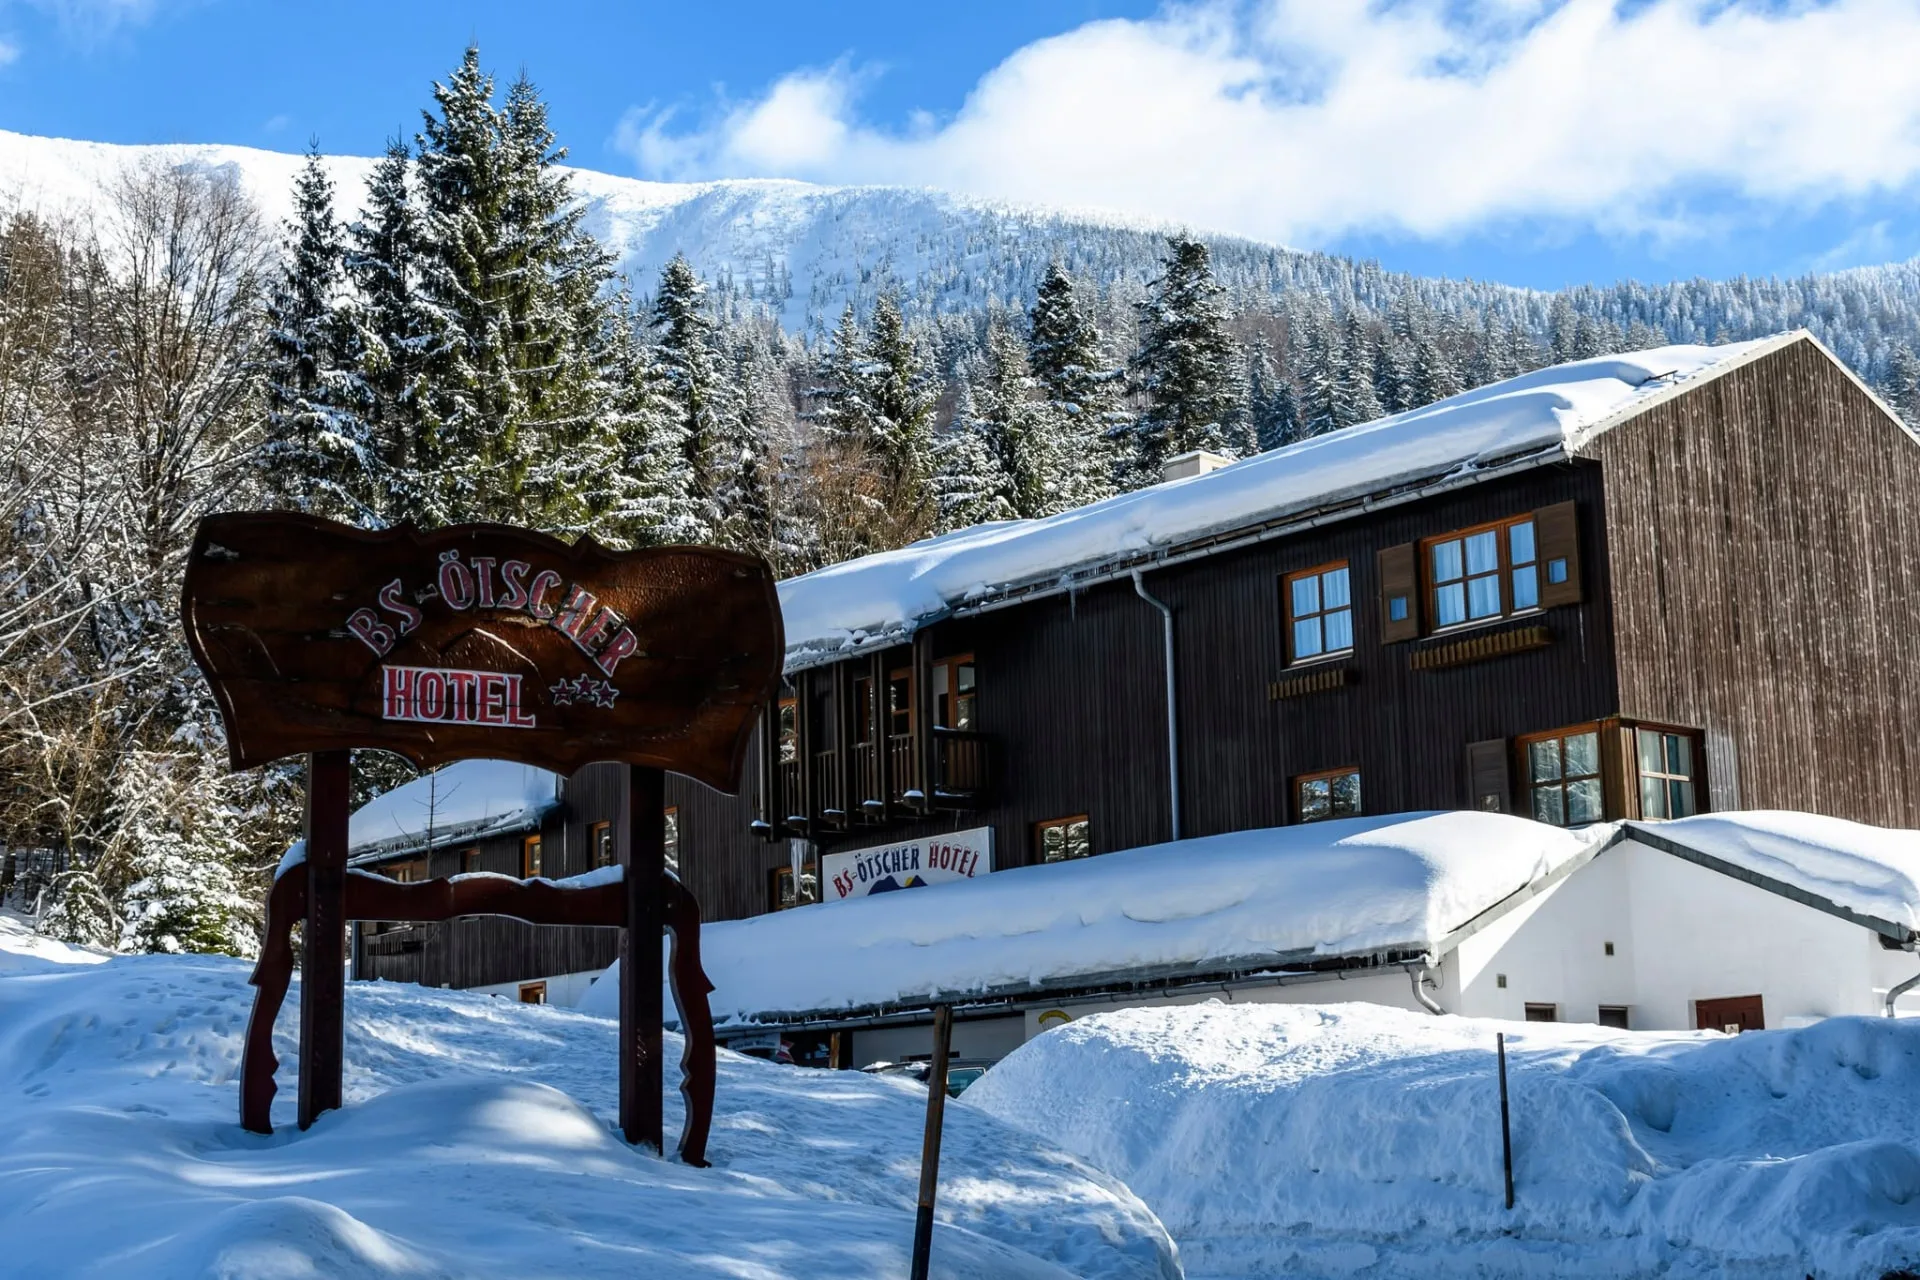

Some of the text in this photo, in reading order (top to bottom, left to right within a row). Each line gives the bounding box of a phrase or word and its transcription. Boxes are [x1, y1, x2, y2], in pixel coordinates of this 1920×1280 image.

[346, 549, 638, 678] BS-ÖTSCHER
[382, 665, 536, 728] HOTEL
[832, 841, 980, 898] BS-ÖTSCHER HOTEL
